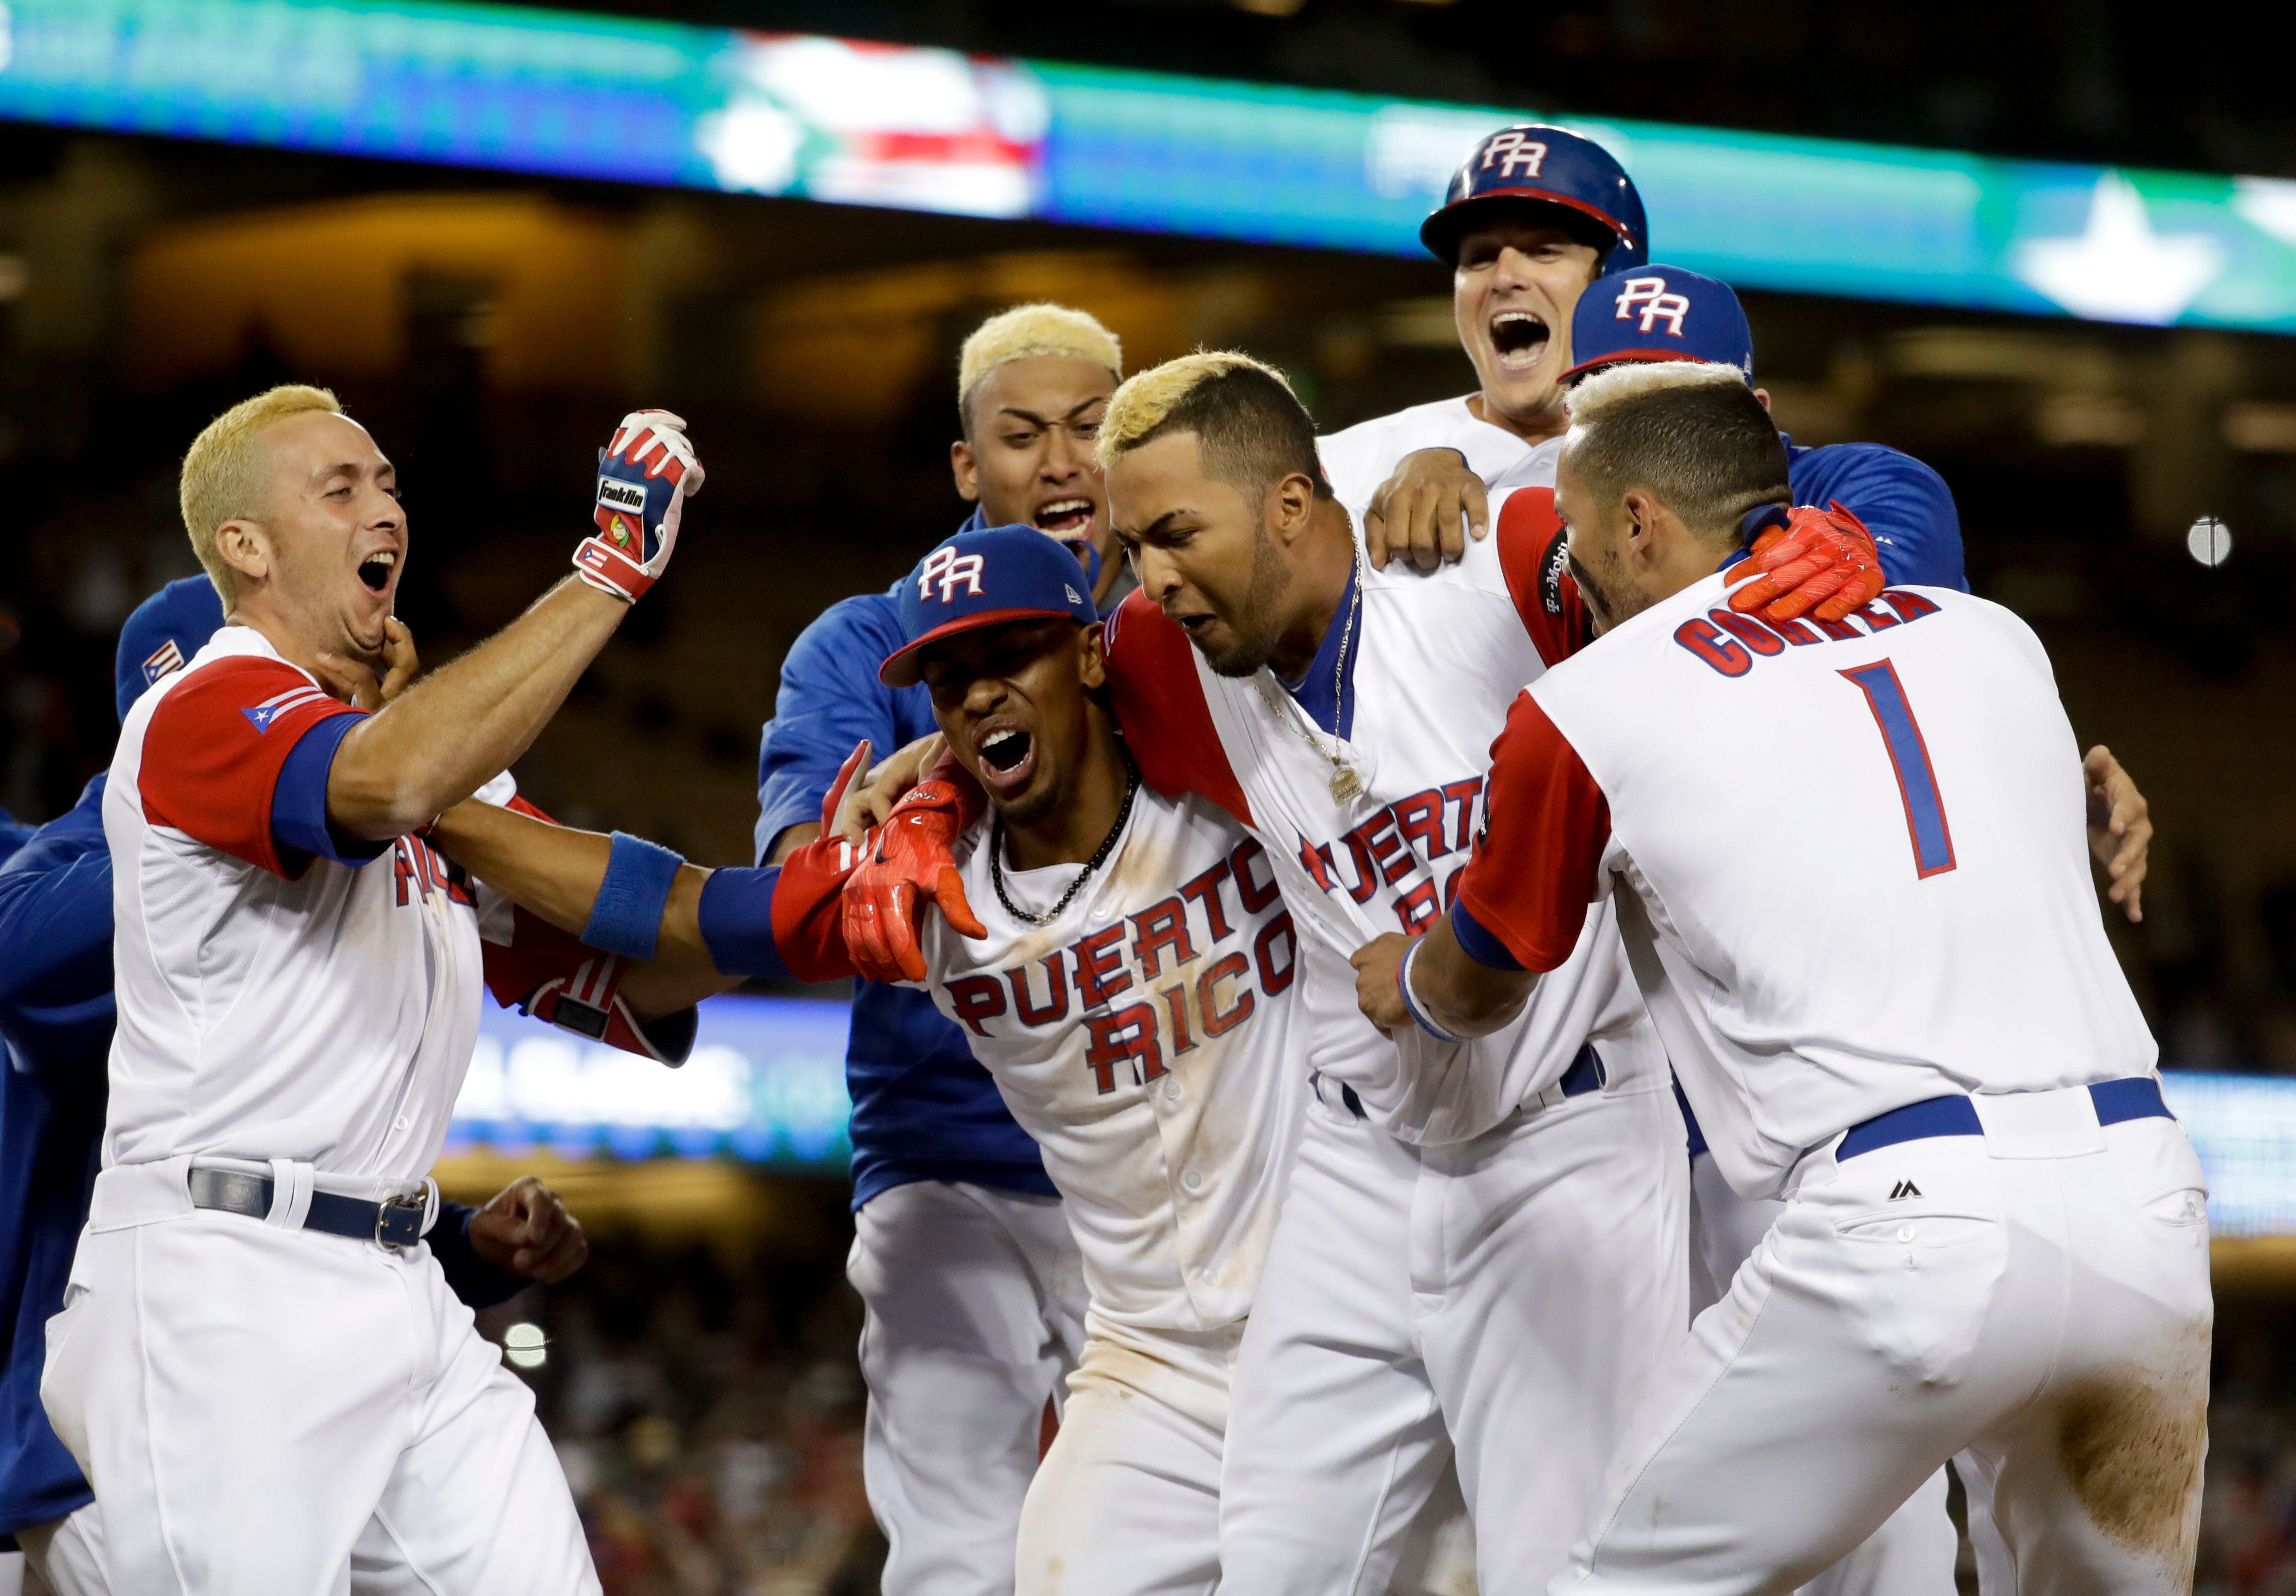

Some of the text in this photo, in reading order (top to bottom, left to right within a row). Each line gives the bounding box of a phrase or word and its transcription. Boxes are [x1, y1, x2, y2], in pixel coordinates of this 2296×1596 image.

[1481, 132, 1549, 178] PR
[1615, 277, 1690, 339] PR
[918, 545, 986, 605] PR
[1546, 542, 1567, 614] T-Mobil
[1834, 656, 1957, 880] 1
[1297, 774, 1491, 904] UERT
[942, 838, 1285, 1038] PUERTO
[1081, 909, 1297, 1096] RICO
